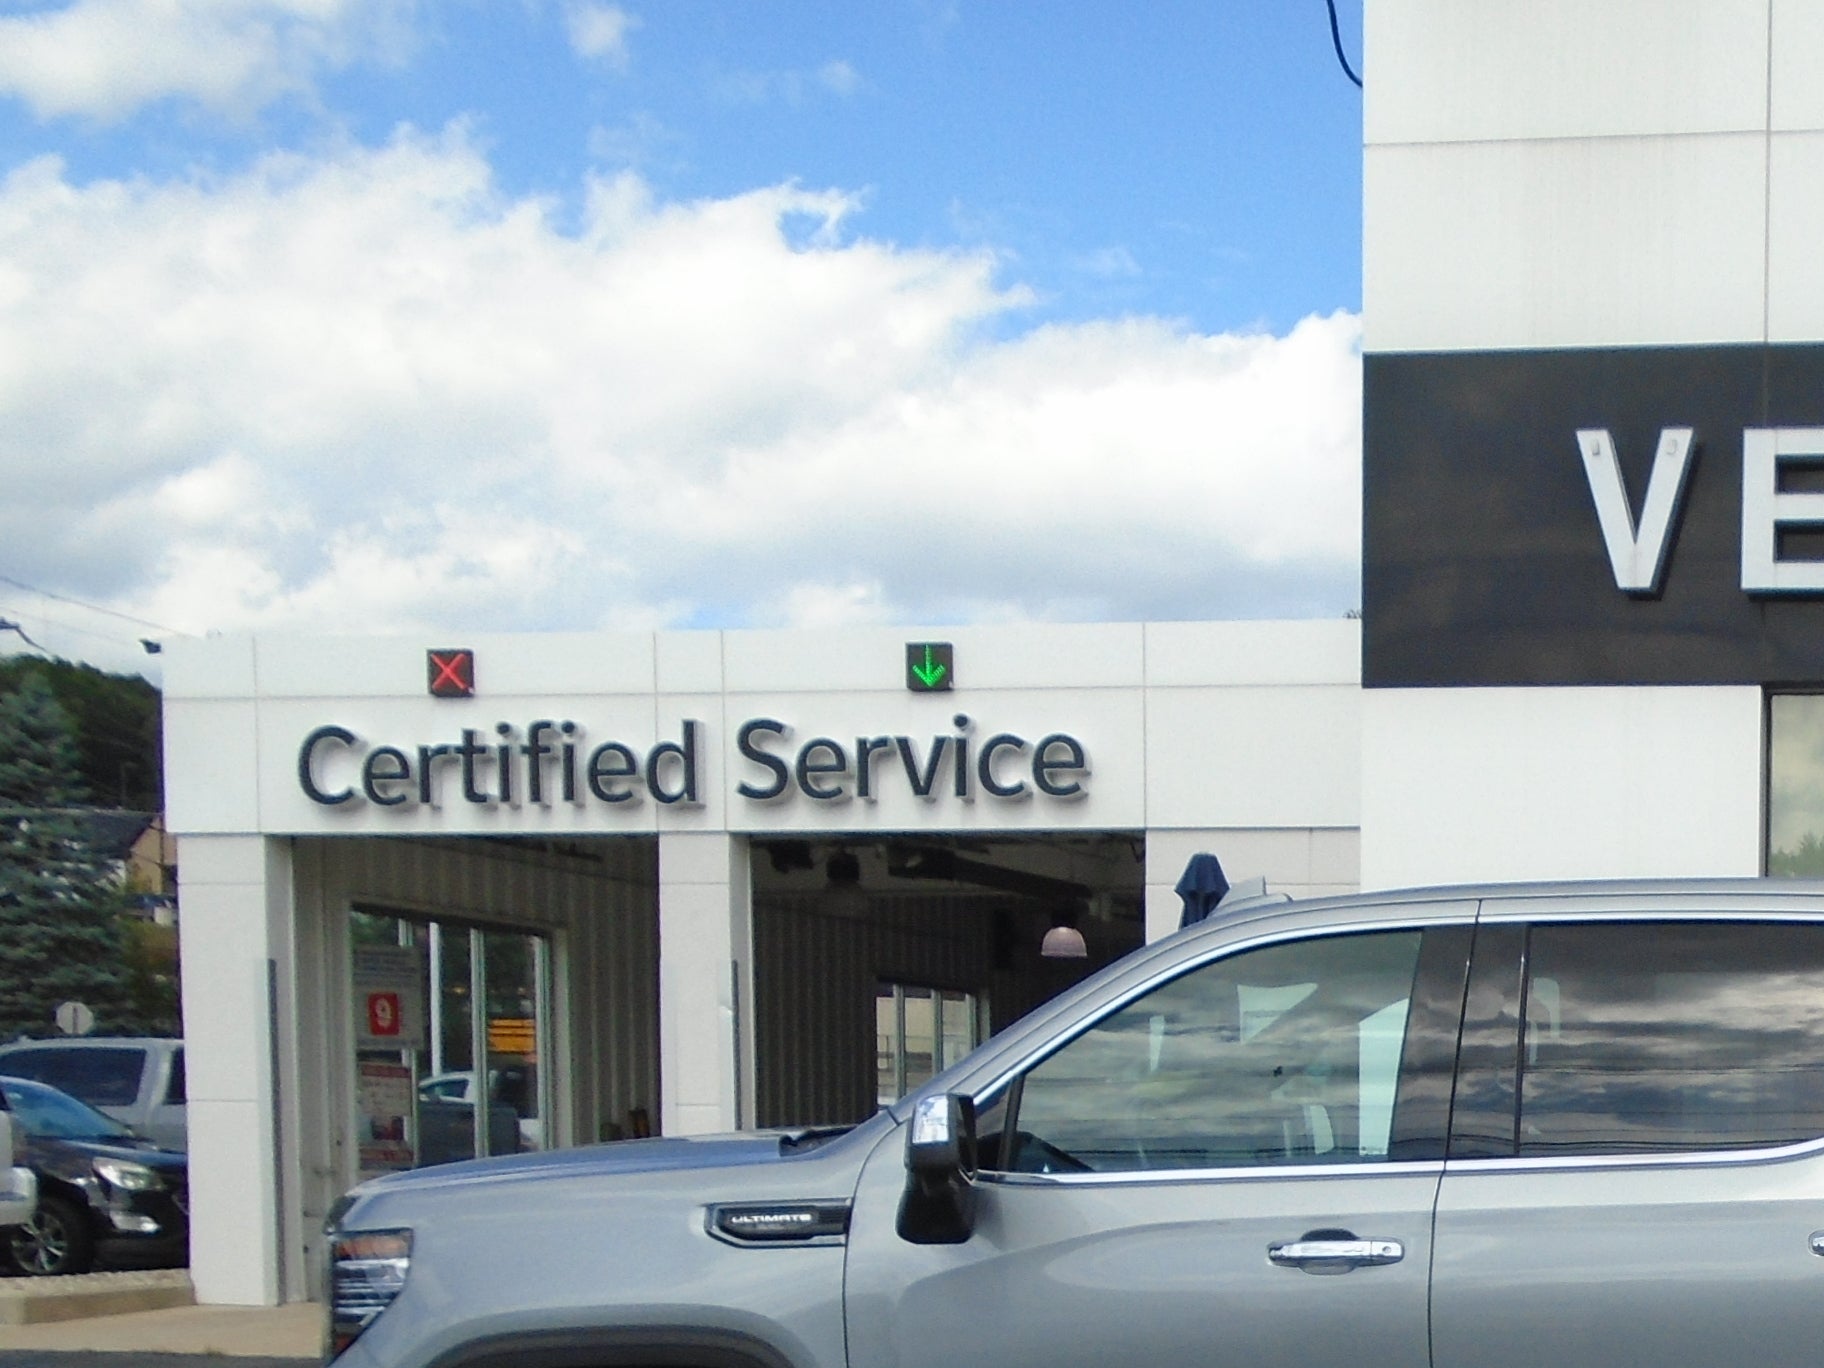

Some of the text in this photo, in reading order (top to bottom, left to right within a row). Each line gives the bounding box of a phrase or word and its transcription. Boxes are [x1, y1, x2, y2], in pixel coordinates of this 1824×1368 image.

[298, 714, 1088, 805] Certified Service
[731, 1213, 813, 1224] ULTIMATE
